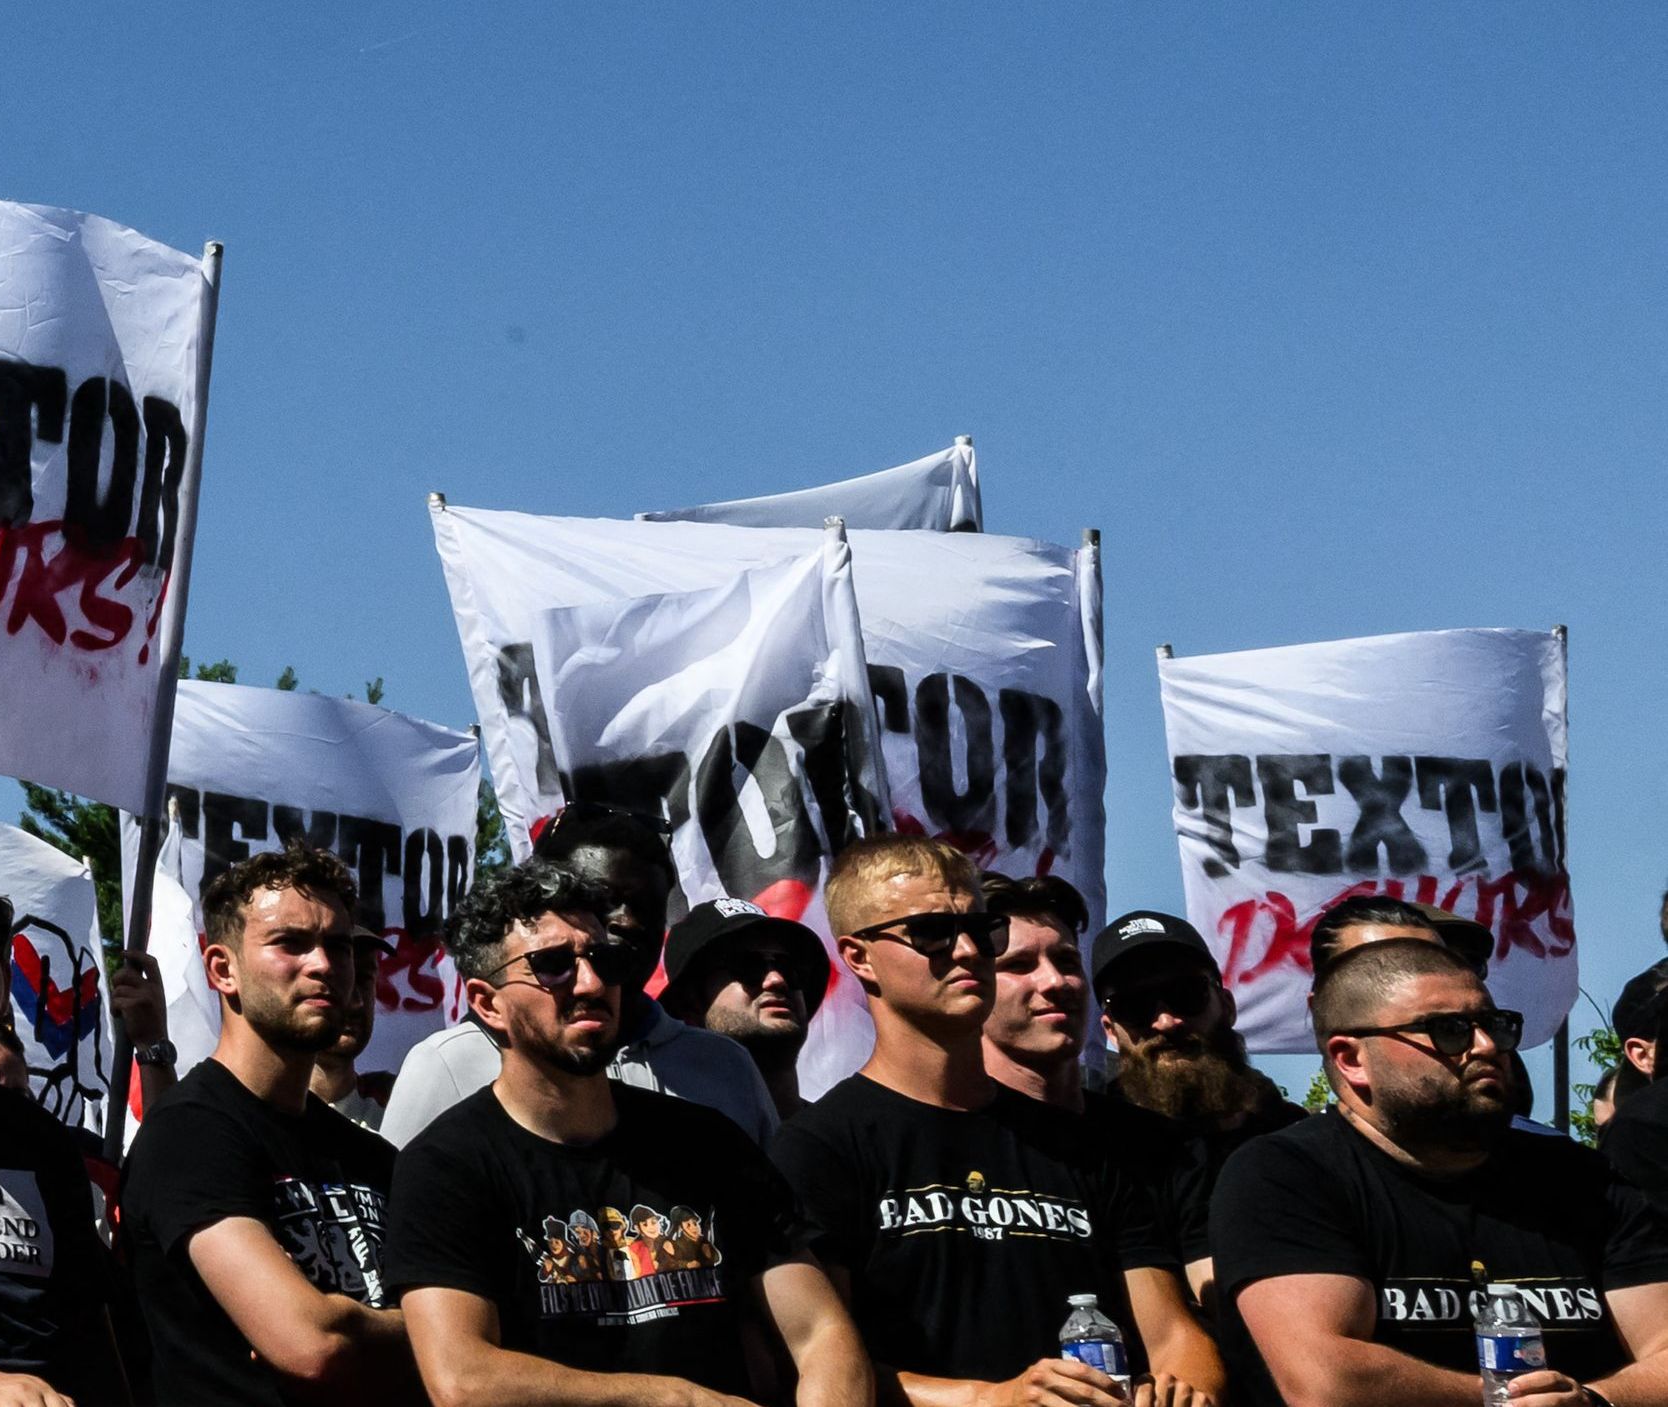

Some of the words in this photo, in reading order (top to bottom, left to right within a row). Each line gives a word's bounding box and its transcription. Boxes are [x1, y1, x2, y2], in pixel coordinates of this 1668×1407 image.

[1173, 752, 1566, 882] TEXTO
[879, 1191, 955, 1230] BAD
[960, 1196, 1093, 1238] GONES
[971, 1225, 1004, 1241] 1987
[1381, 1286, 1462, 1321] BAD
